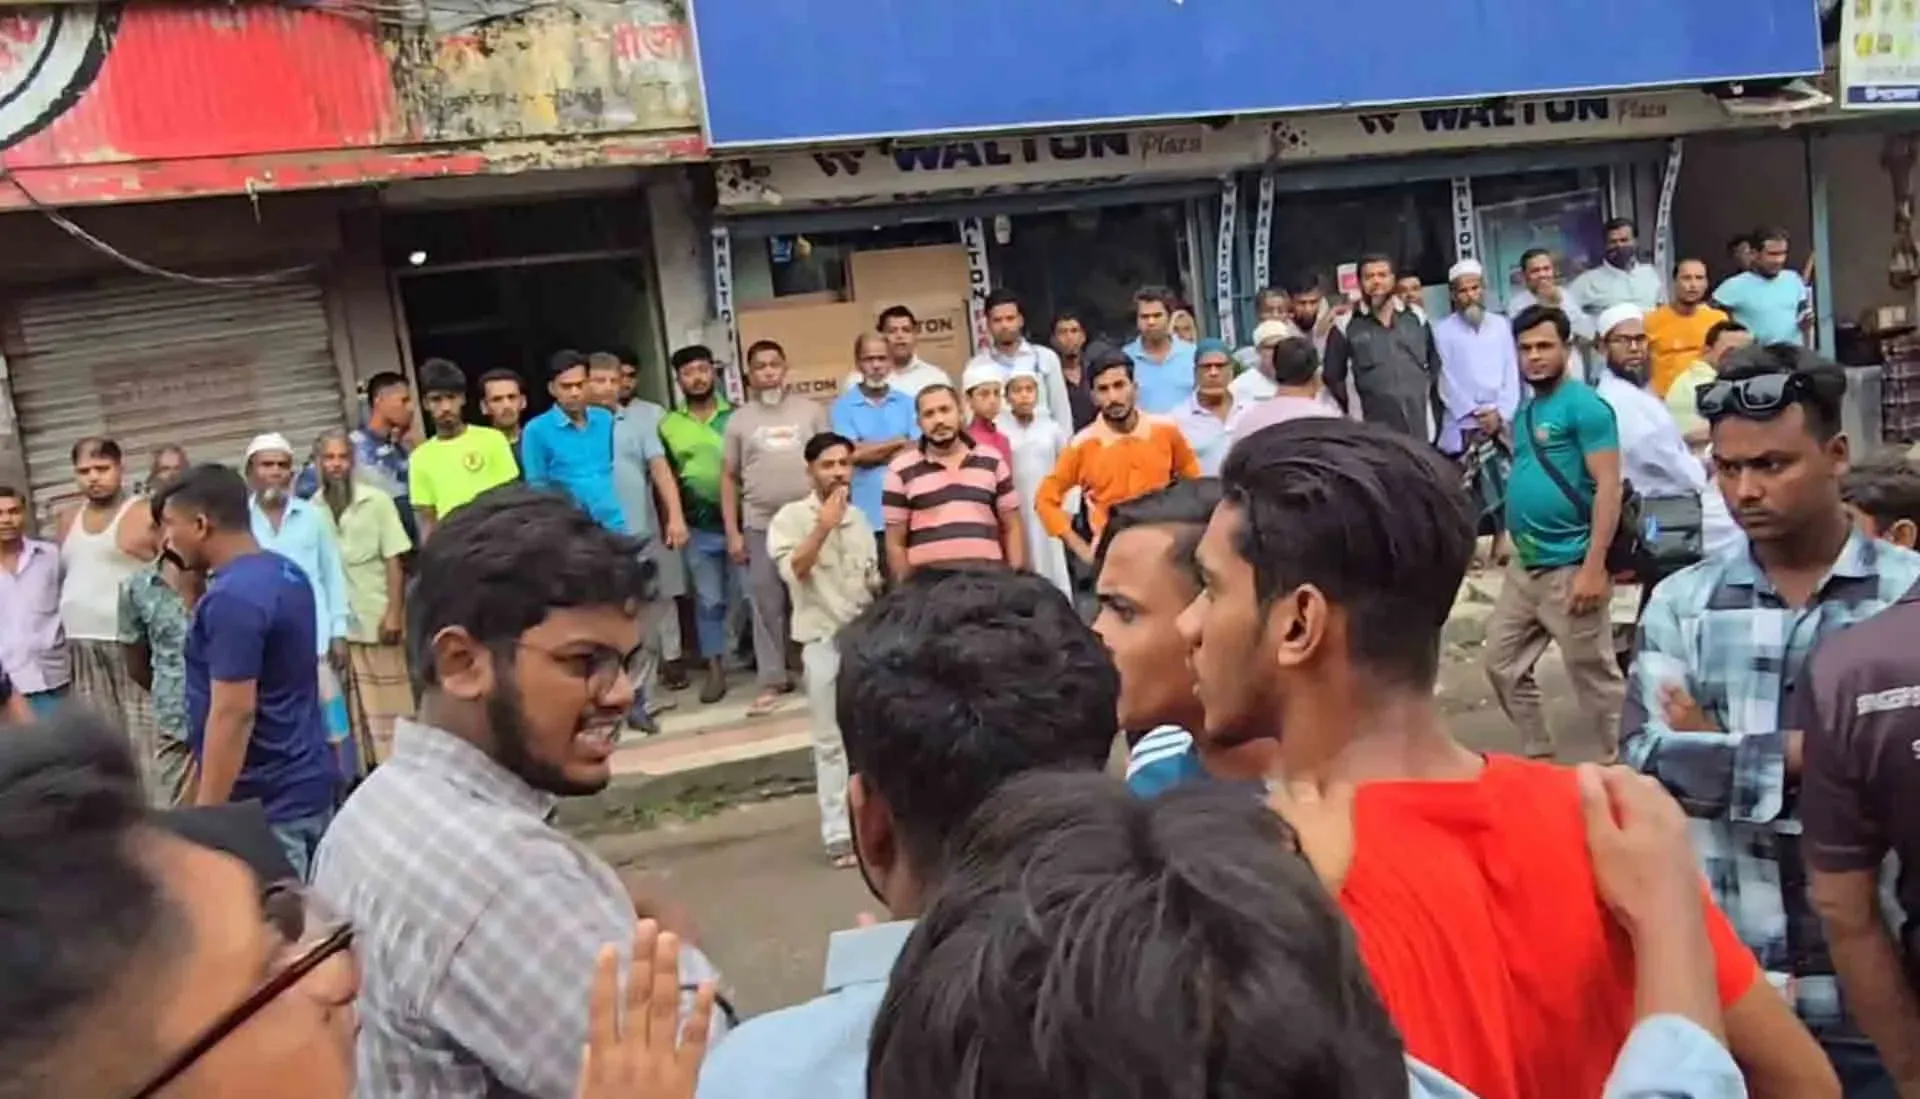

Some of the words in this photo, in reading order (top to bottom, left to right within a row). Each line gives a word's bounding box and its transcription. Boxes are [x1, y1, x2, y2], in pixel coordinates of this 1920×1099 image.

[964, 215, 985, 299] ALTON
[1256, 200, 1270, 279] WALTO
[1453, 177, 1471, 260] ALTON
[916, 317, 953, 334] TON
